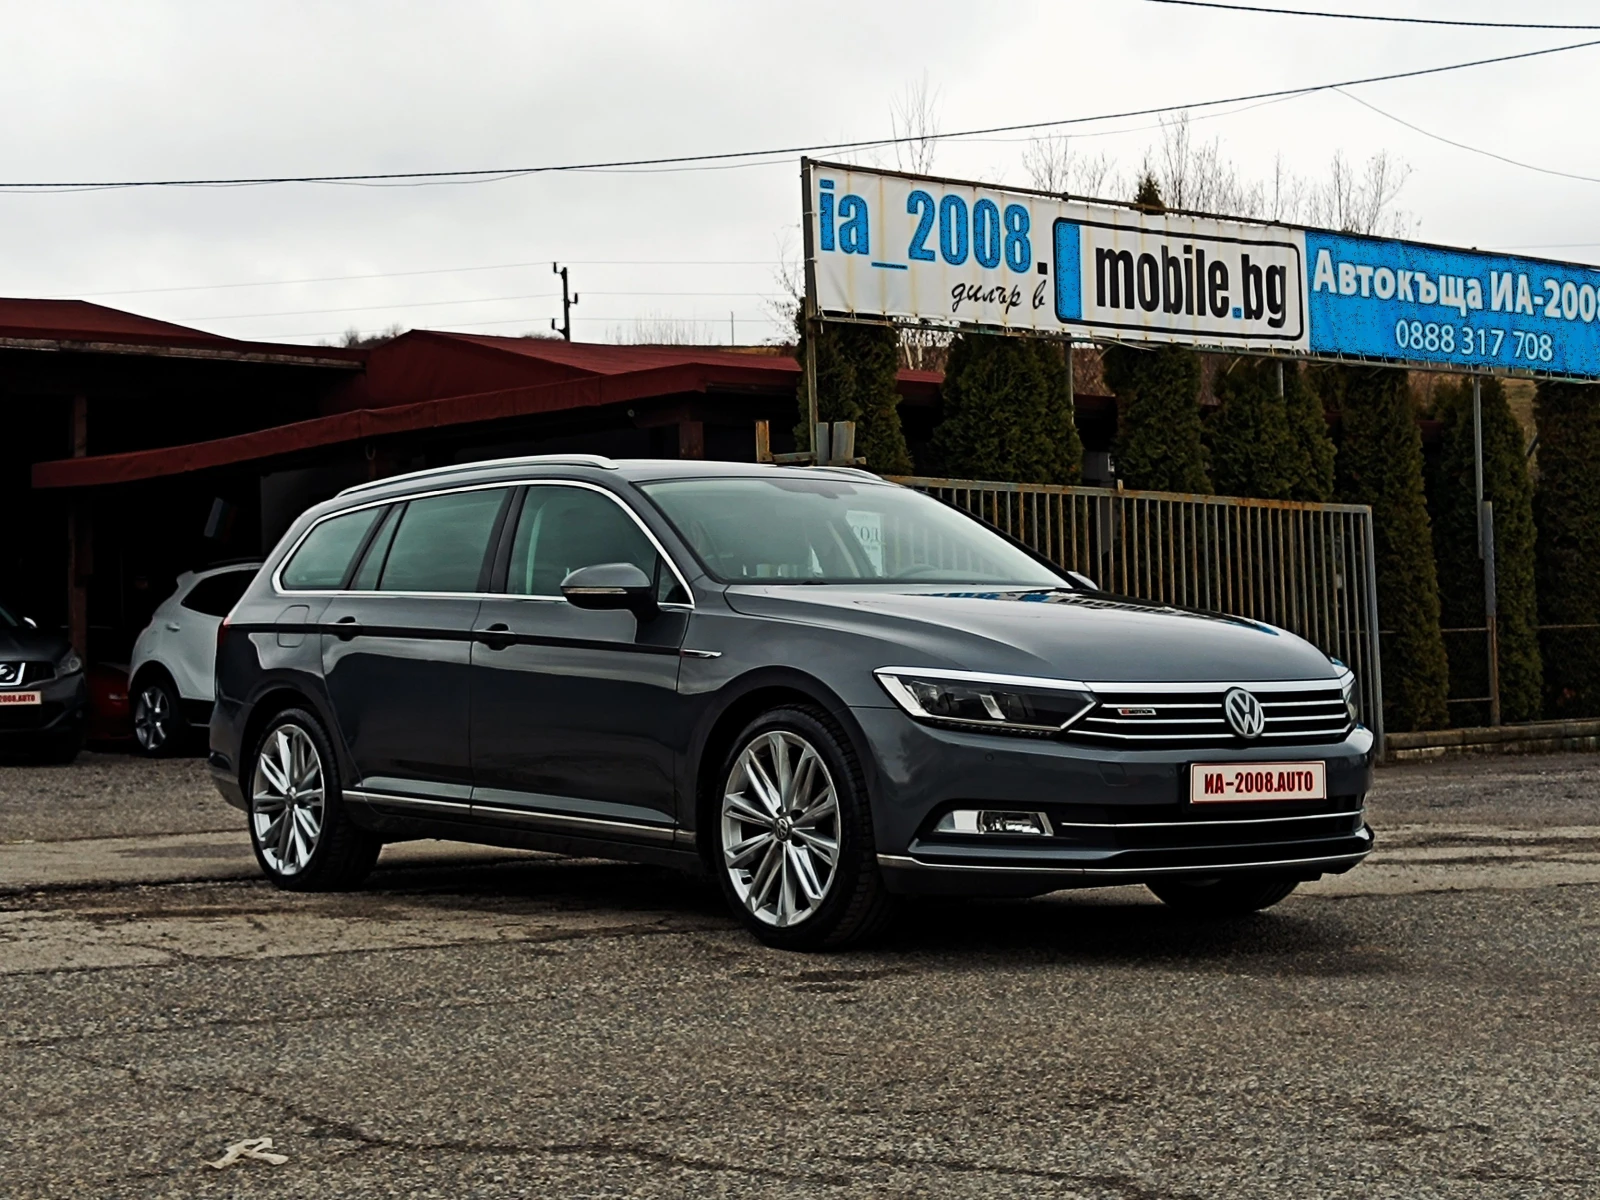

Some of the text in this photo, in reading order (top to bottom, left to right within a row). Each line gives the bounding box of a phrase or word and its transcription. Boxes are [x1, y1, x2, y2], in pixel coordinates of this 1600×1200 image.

[951, 279, 1047, 314] дилър в
[1096, 245, 1286, 328] mobile.bg
[1313, 249, 1600, 326] Автокъща ИА-200
[1396, 319, 1553, 361] 0888 317 708
